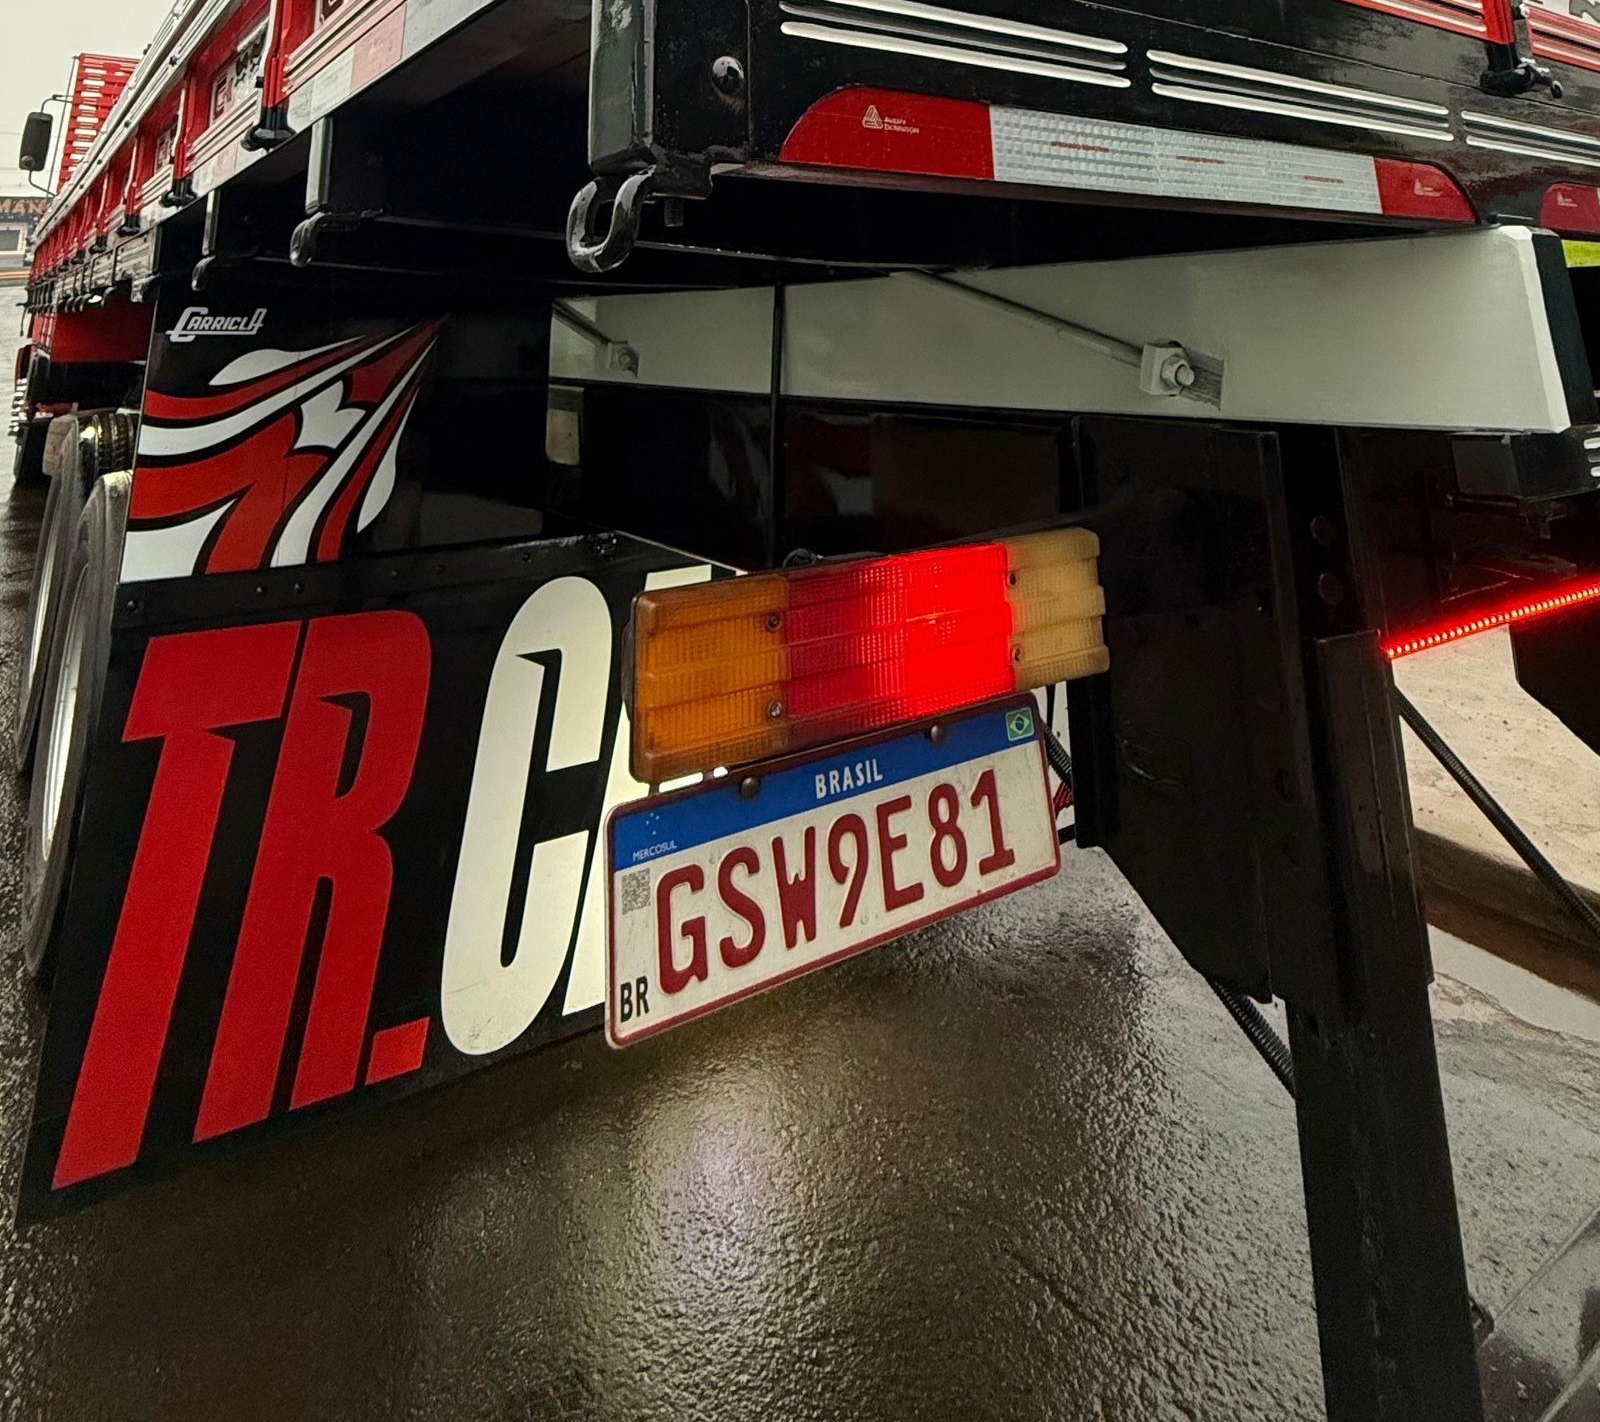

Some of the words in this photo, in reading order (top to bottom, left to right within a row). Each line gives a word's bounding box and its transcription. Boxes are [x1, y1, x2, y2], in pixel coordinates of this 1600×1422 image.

[815, 758, 884, 799] BRASIL
[632, 839, 678, 862] MERCOSUL
[656, 769, 1016, 996] GSW9E81
[619, 976, 651, 1024] BR
